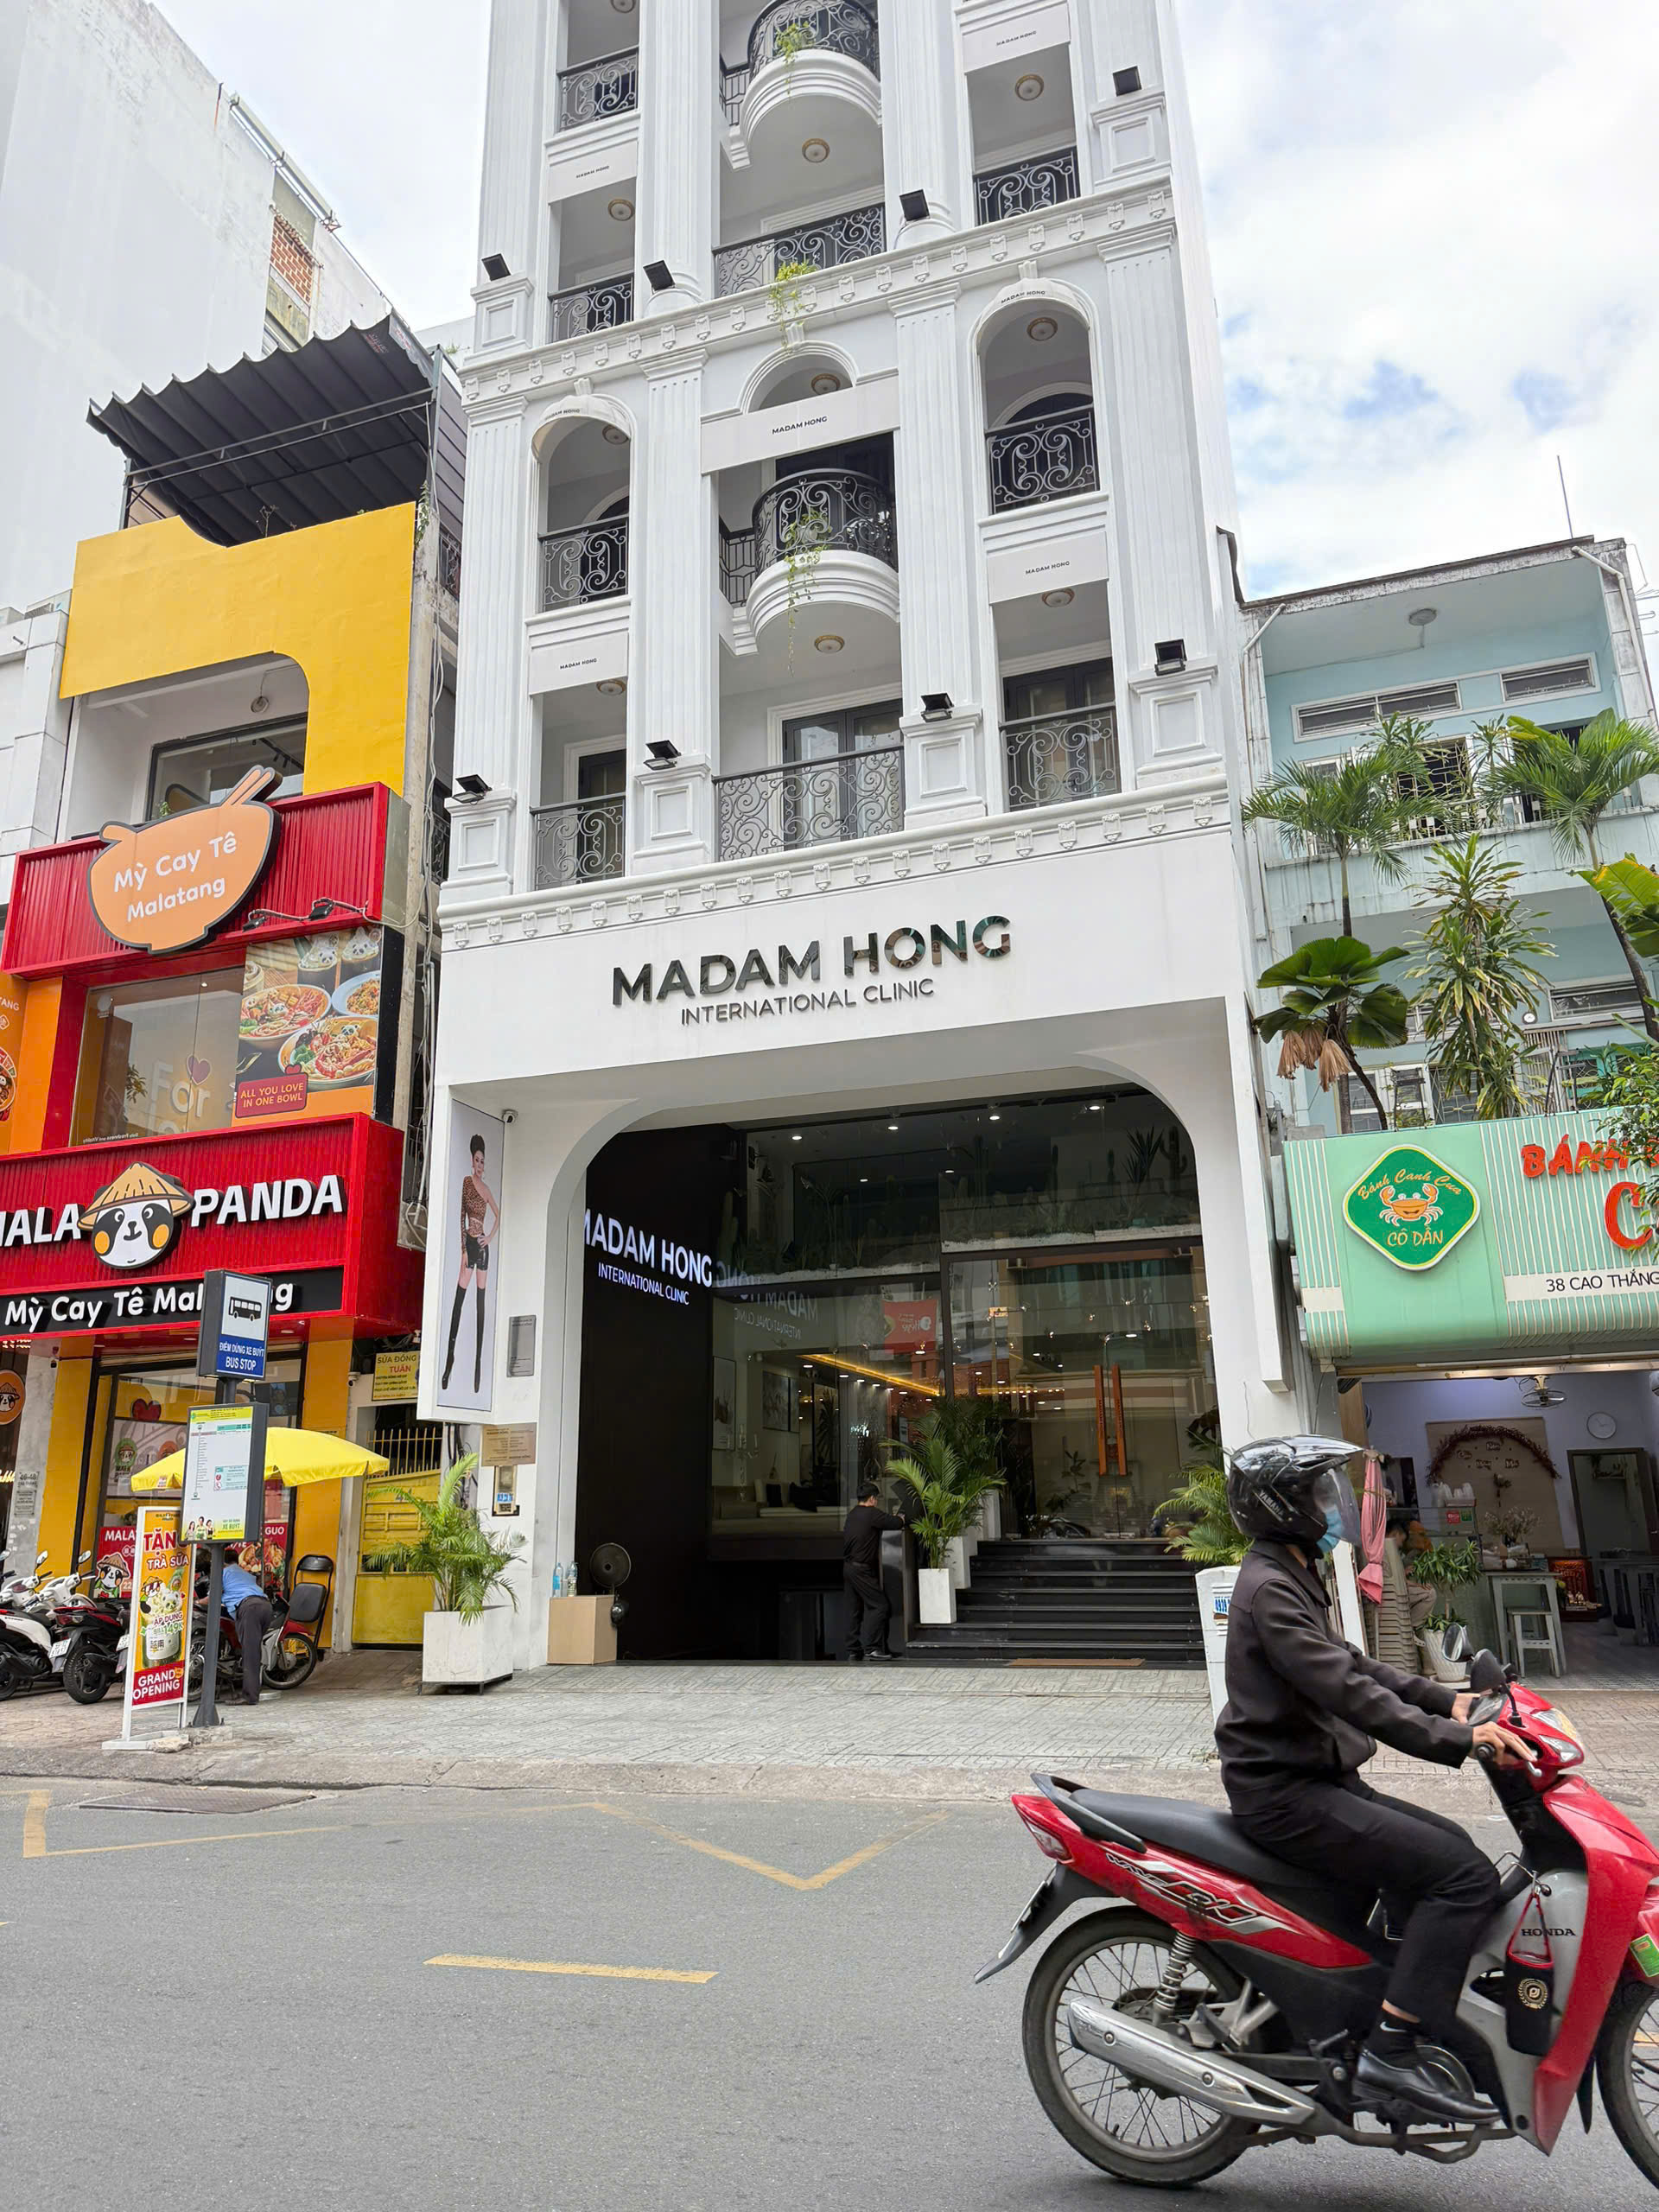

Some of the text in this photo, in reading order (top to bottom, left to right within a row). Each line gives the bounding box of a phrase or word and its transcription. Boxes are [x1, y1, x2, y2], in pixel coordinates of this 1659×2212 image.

[1001, 292, 1025, 304] MADAM
[772, 416, 828, 435] MADAM HONG
[1025, 561, 1071, 575] MADAM HONG
[114, 830, 238, 892] Mỳ Cay Tê
[127, 877, 226, 923] Malatang
[612, 915, 1011, 1006] MADAM HONG
[681, 977, 935, 1026] INTERNATIONAL CLINIC
[240, 1083, 304, 1099] ALL YOU LOVE
[243, 1092, 302, 1109] IN ONE BOWL
[1357, 1168, 1462, 1199] Bánh Canh Cua
[191, 1174, 343, 1228] PANDA
[1387, 1228, 1408, 1246] CÔ
[662, 1239, 712, 1287] HONG
[598, 1262, 690, 1305] INTERNATIONAL CLINIC
[1546, 1268, 1659, 1293] 38 CAO THẮNG
[5, 1297, 43, 1333] Mỳ
[51, 1296, 103, 1327] Cay
[113, 1287, 144, 1317] Tê
[226, 1357, 257, 1371] BUS STOP
[105, 1526, 284, 1541] MALA GUO
[147, 1552, 189, 1570] TRÀ SỮA
[138, 1669, 175, 1687] GRAND
[134, 1680, 180, 1700] OPENING
